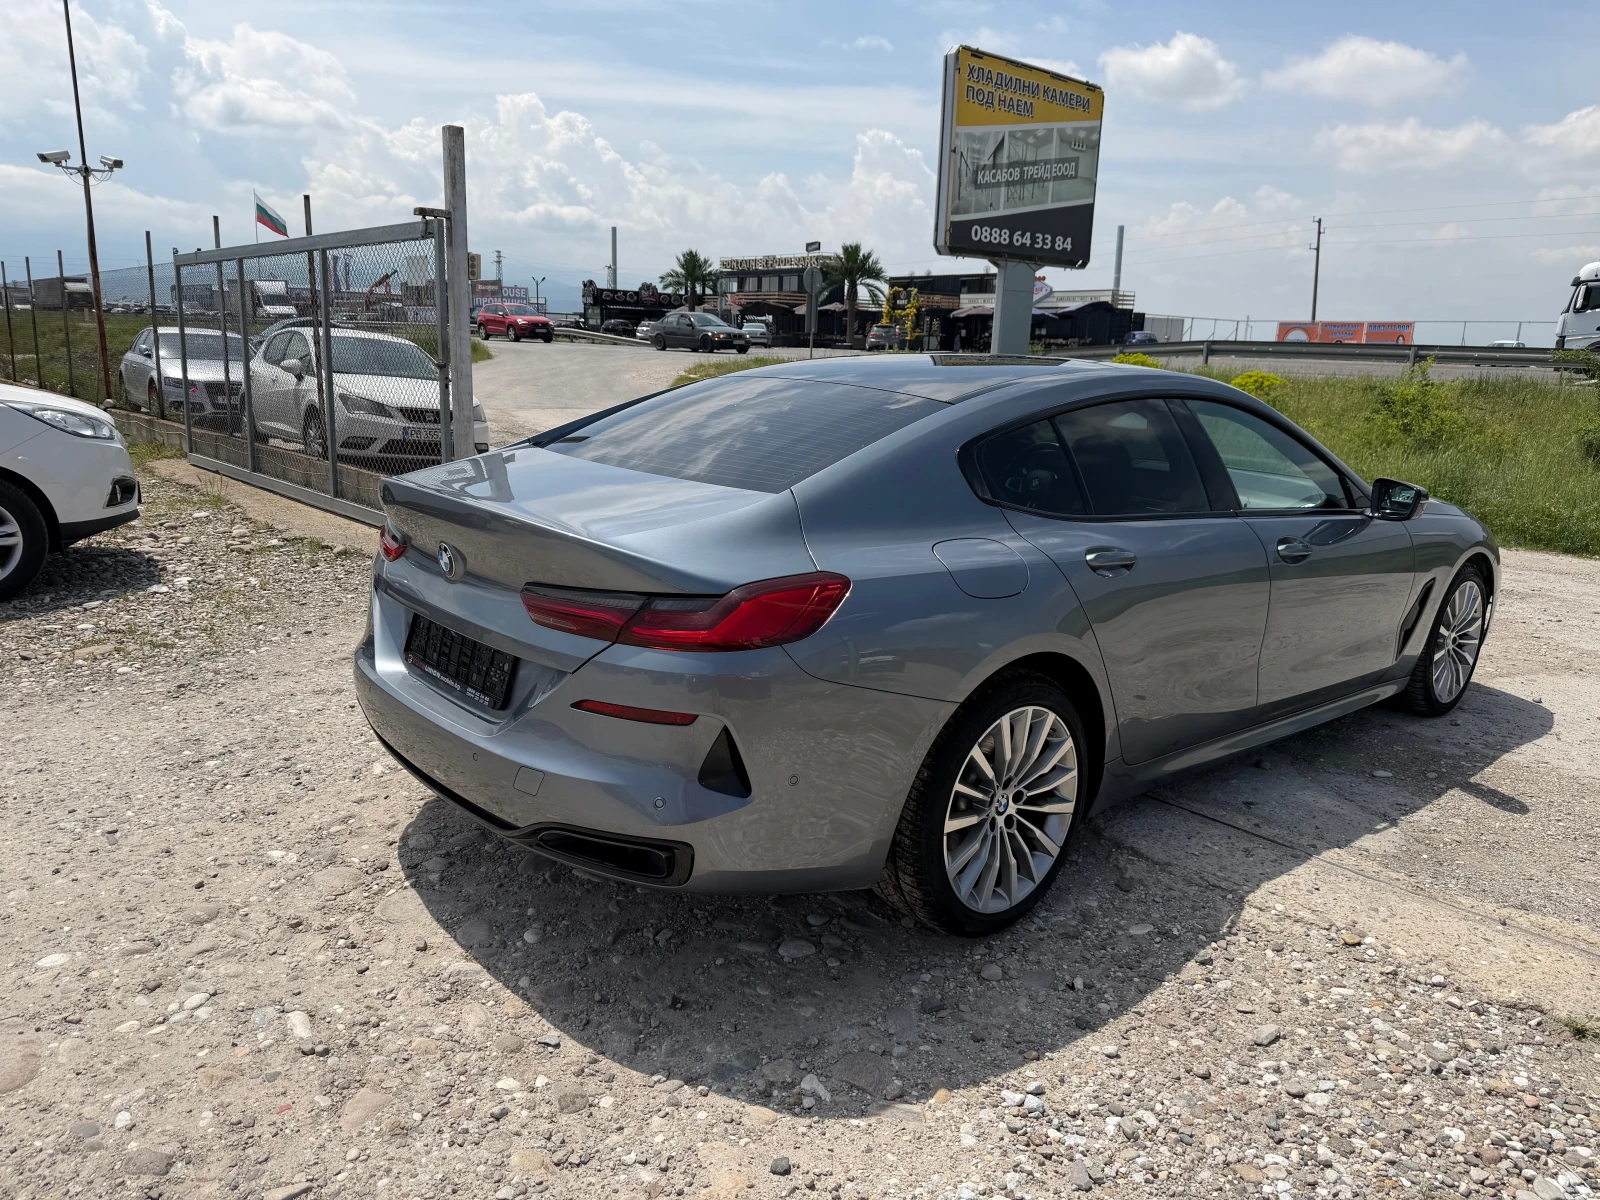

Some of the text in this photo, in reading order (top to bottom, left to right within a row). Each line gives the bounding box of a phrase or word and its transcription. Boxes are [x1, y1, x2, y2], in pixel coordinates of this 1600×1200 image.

[967, 63, 1091, 113] ХЛАДИЛНИ КАМЕРИ
[966, 84, 1034, 118] ПОД НАЕМ
[977, 162, 1076, 185] КАСАБОВ ТРЕЙД ЕООД
[971, 225, 1072, 251] 0888 64 33 84
[721, 254, 818, 270] CONTAINER FOOD PARK
[502, 287, 526, 298] OUSE
